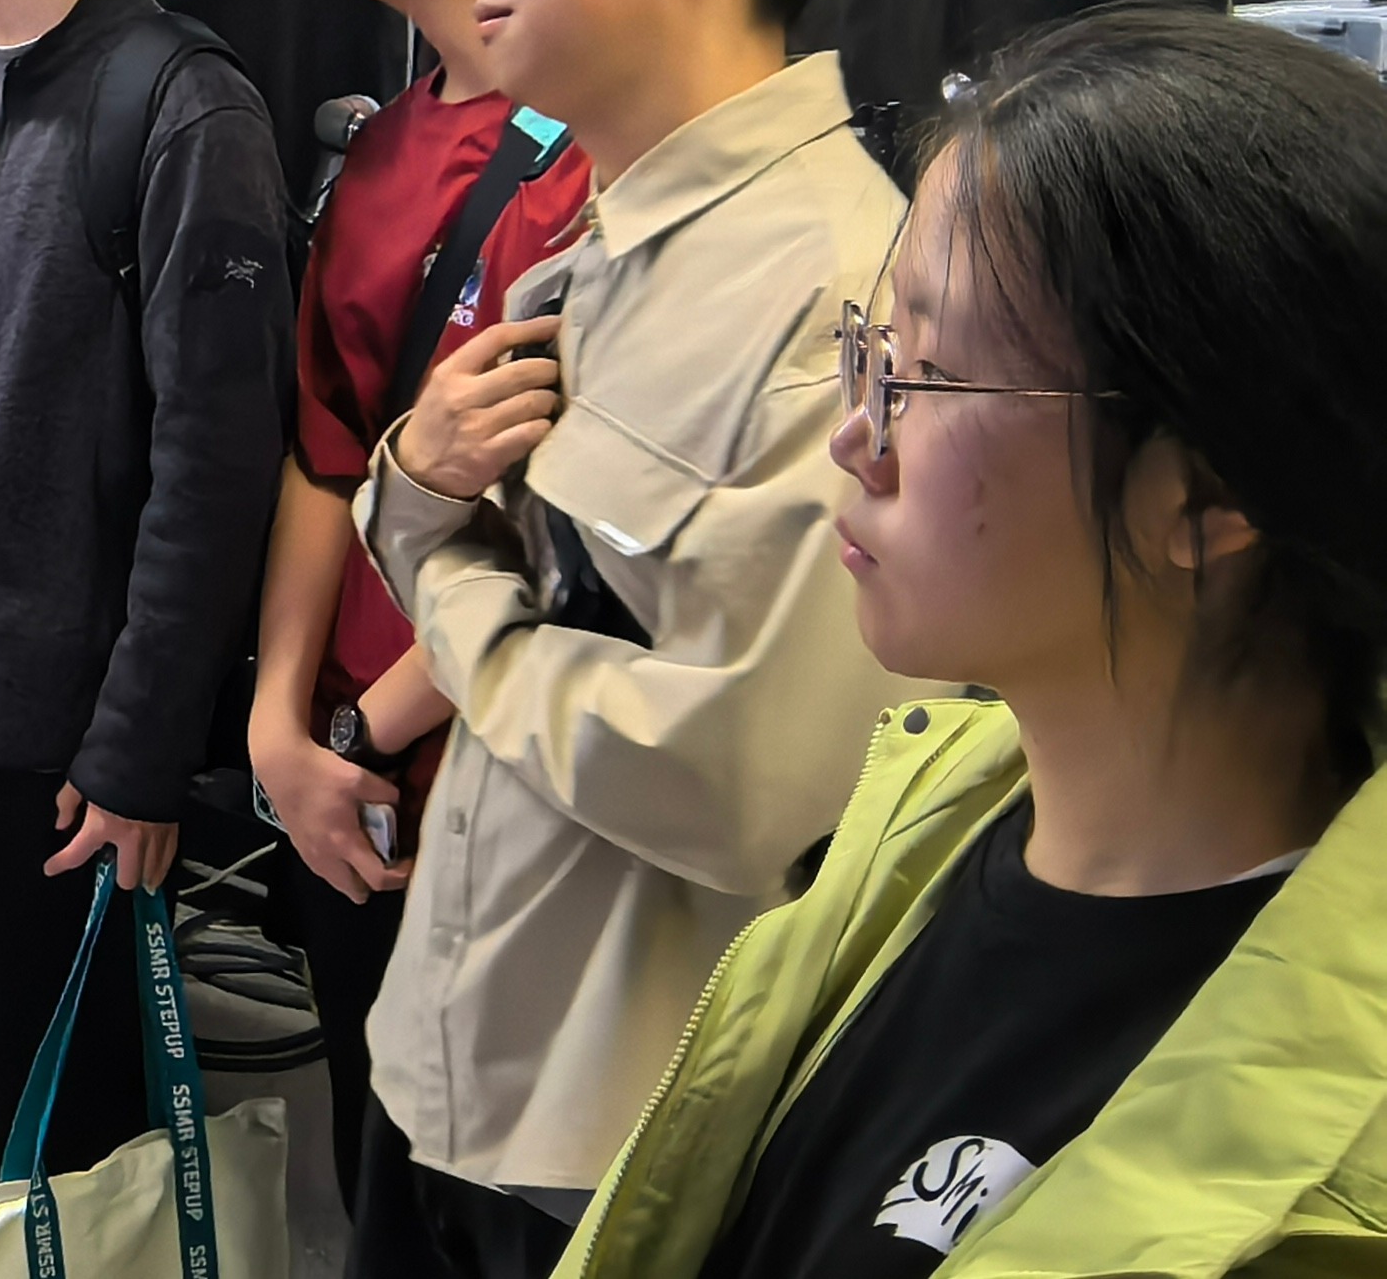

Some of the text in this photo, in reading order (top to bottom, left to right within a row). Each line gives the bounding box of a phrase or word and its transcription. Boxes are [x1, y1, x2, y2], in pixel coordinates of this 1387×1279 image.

[146, 923, 185, 1058] SSMR STEPUP
[172, 1084, 204, 1221] SSMR STEPUP
[189, 1245, 206, 1279] SSM
